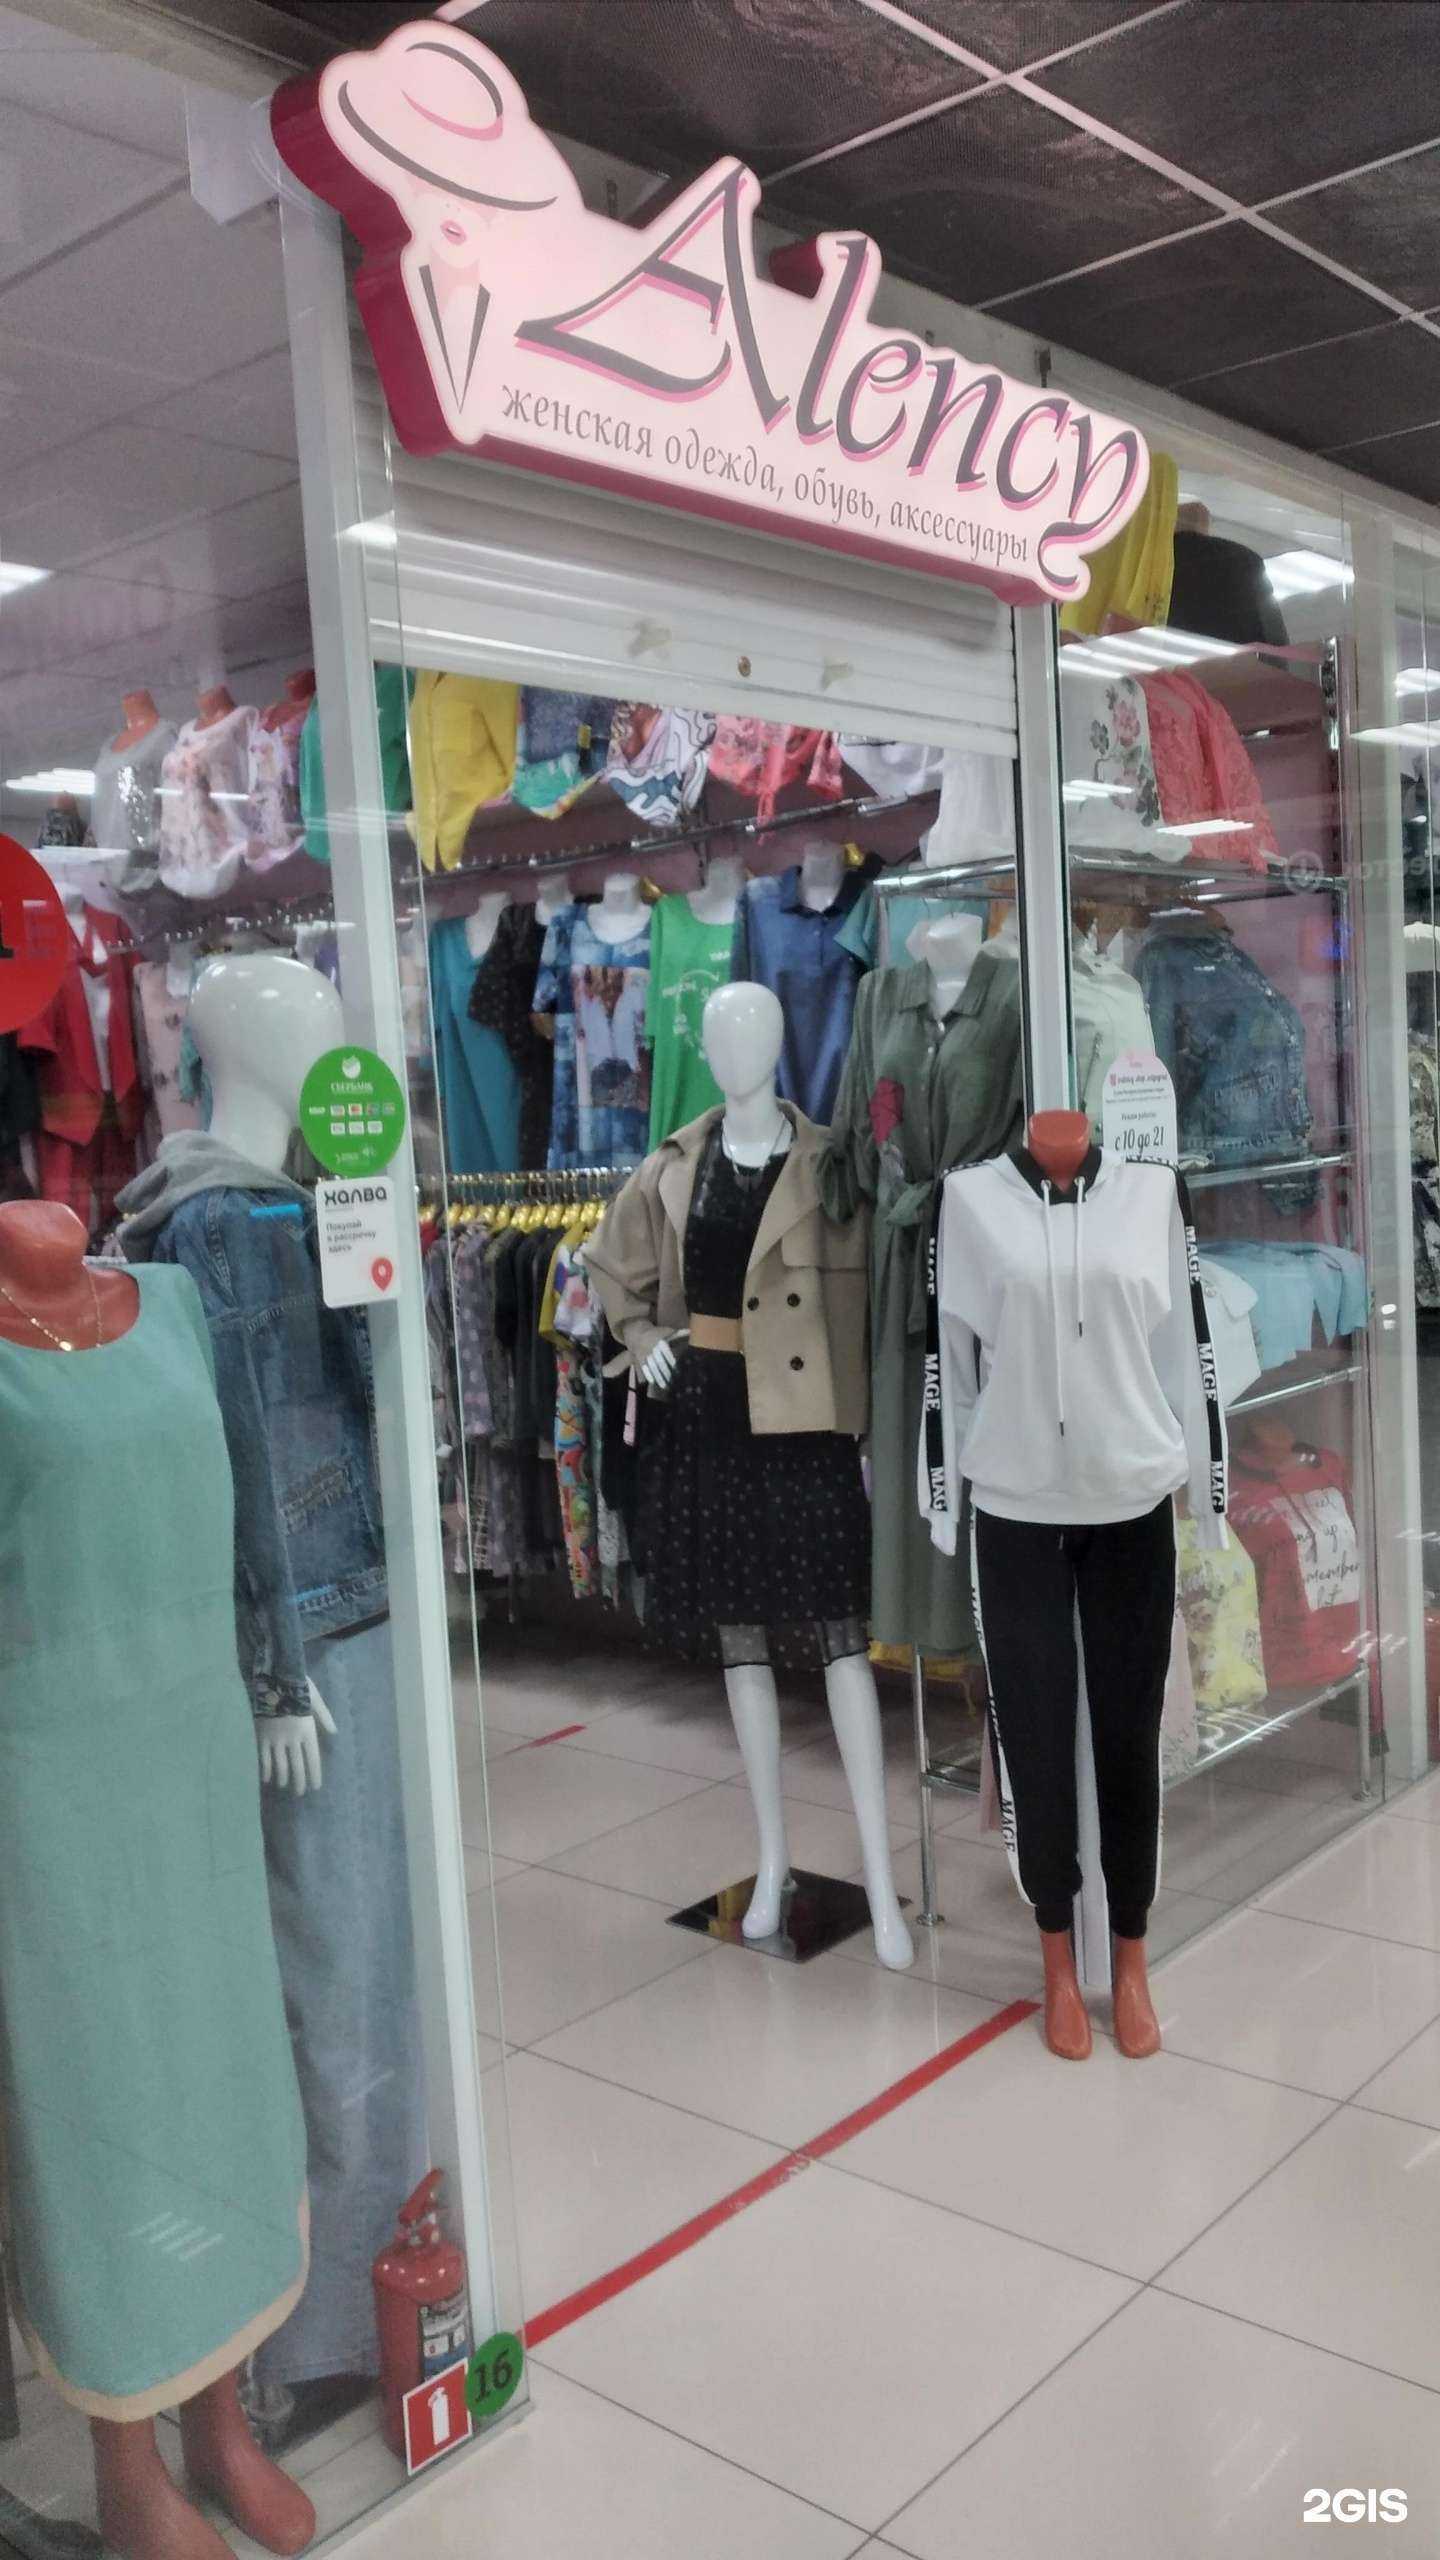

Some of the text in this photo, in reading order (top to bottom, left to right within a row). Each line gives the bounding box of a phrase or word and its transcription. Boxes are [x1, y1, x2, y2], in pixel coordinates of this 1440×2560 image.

[515, 163, 1140, 590] Alency
[502, 384, 1028, 567] женская одежда, обувь, аксессуары
[1123, 1129, 1136, 1150] 10
[1153, 1126, 1165, 1147] 21
[924, 1353, 941, 1412] MAGE
[1198, 1343, 1217, 1402] MAGE
[473, 2347, 513, 2404] 16
